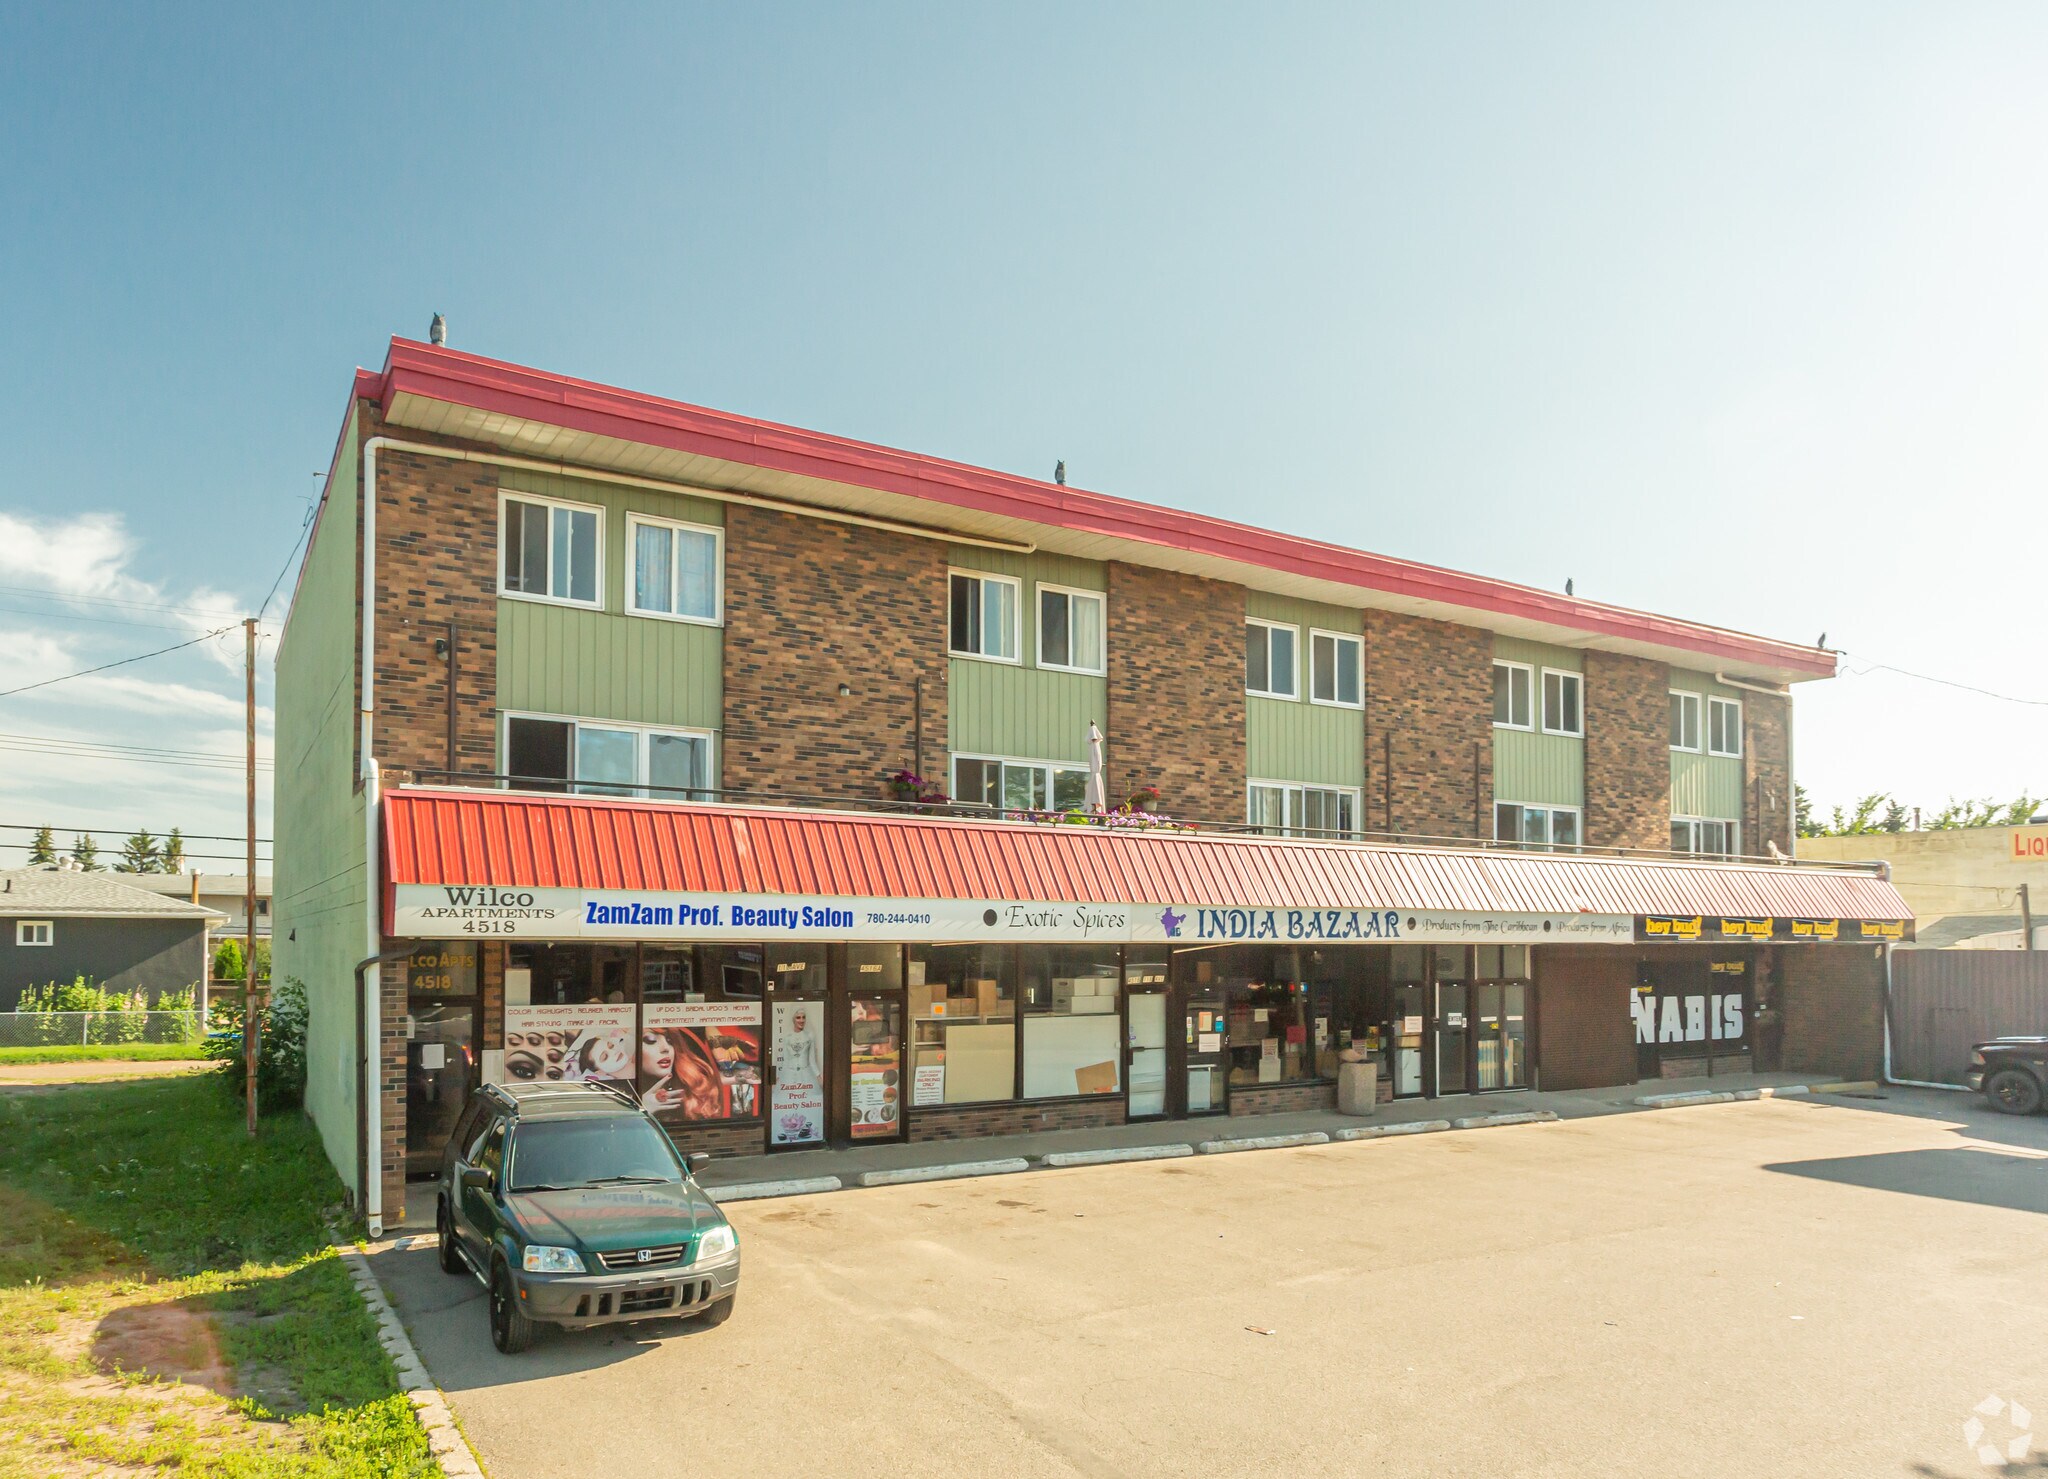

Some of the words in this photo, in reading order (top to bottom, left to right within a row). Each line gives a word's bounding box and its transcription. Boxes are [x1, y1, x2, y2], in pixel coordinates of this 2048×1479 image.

[444, 887, 534, 907] Wilco
[421, 908, 555, 919] APARTMENTS
[586, 902, 673, 925] ZamZam
[679, 904, 723, 926] Prof.
[731, 905, 798, 929] Beauty
[802, 906, 853, 927] Salon
[867, 913, 931, 924] 780-244-0410
[462, 920, 516, 934] 4518
[1005, 905, 1063, 928] Exotic
[1073, 906, 1125, 938] Spices
[1197, 908, 1279, 939] INDIA
[1287, 910, 1400, 939] BAZAAR
[1422, 918, 1460, 931] Products
[1461, 919, 1481, 936] from
[1482, 920, 1499, 935] The
[1500, 920, 1538, 932] Caribbean
[1590, 921, 1607, 936] from
[415, 975, 452, 989] 4518
[780, 1083, 814, 1091] ZamZam
[774, 1103, 799, 1111] Beauty
